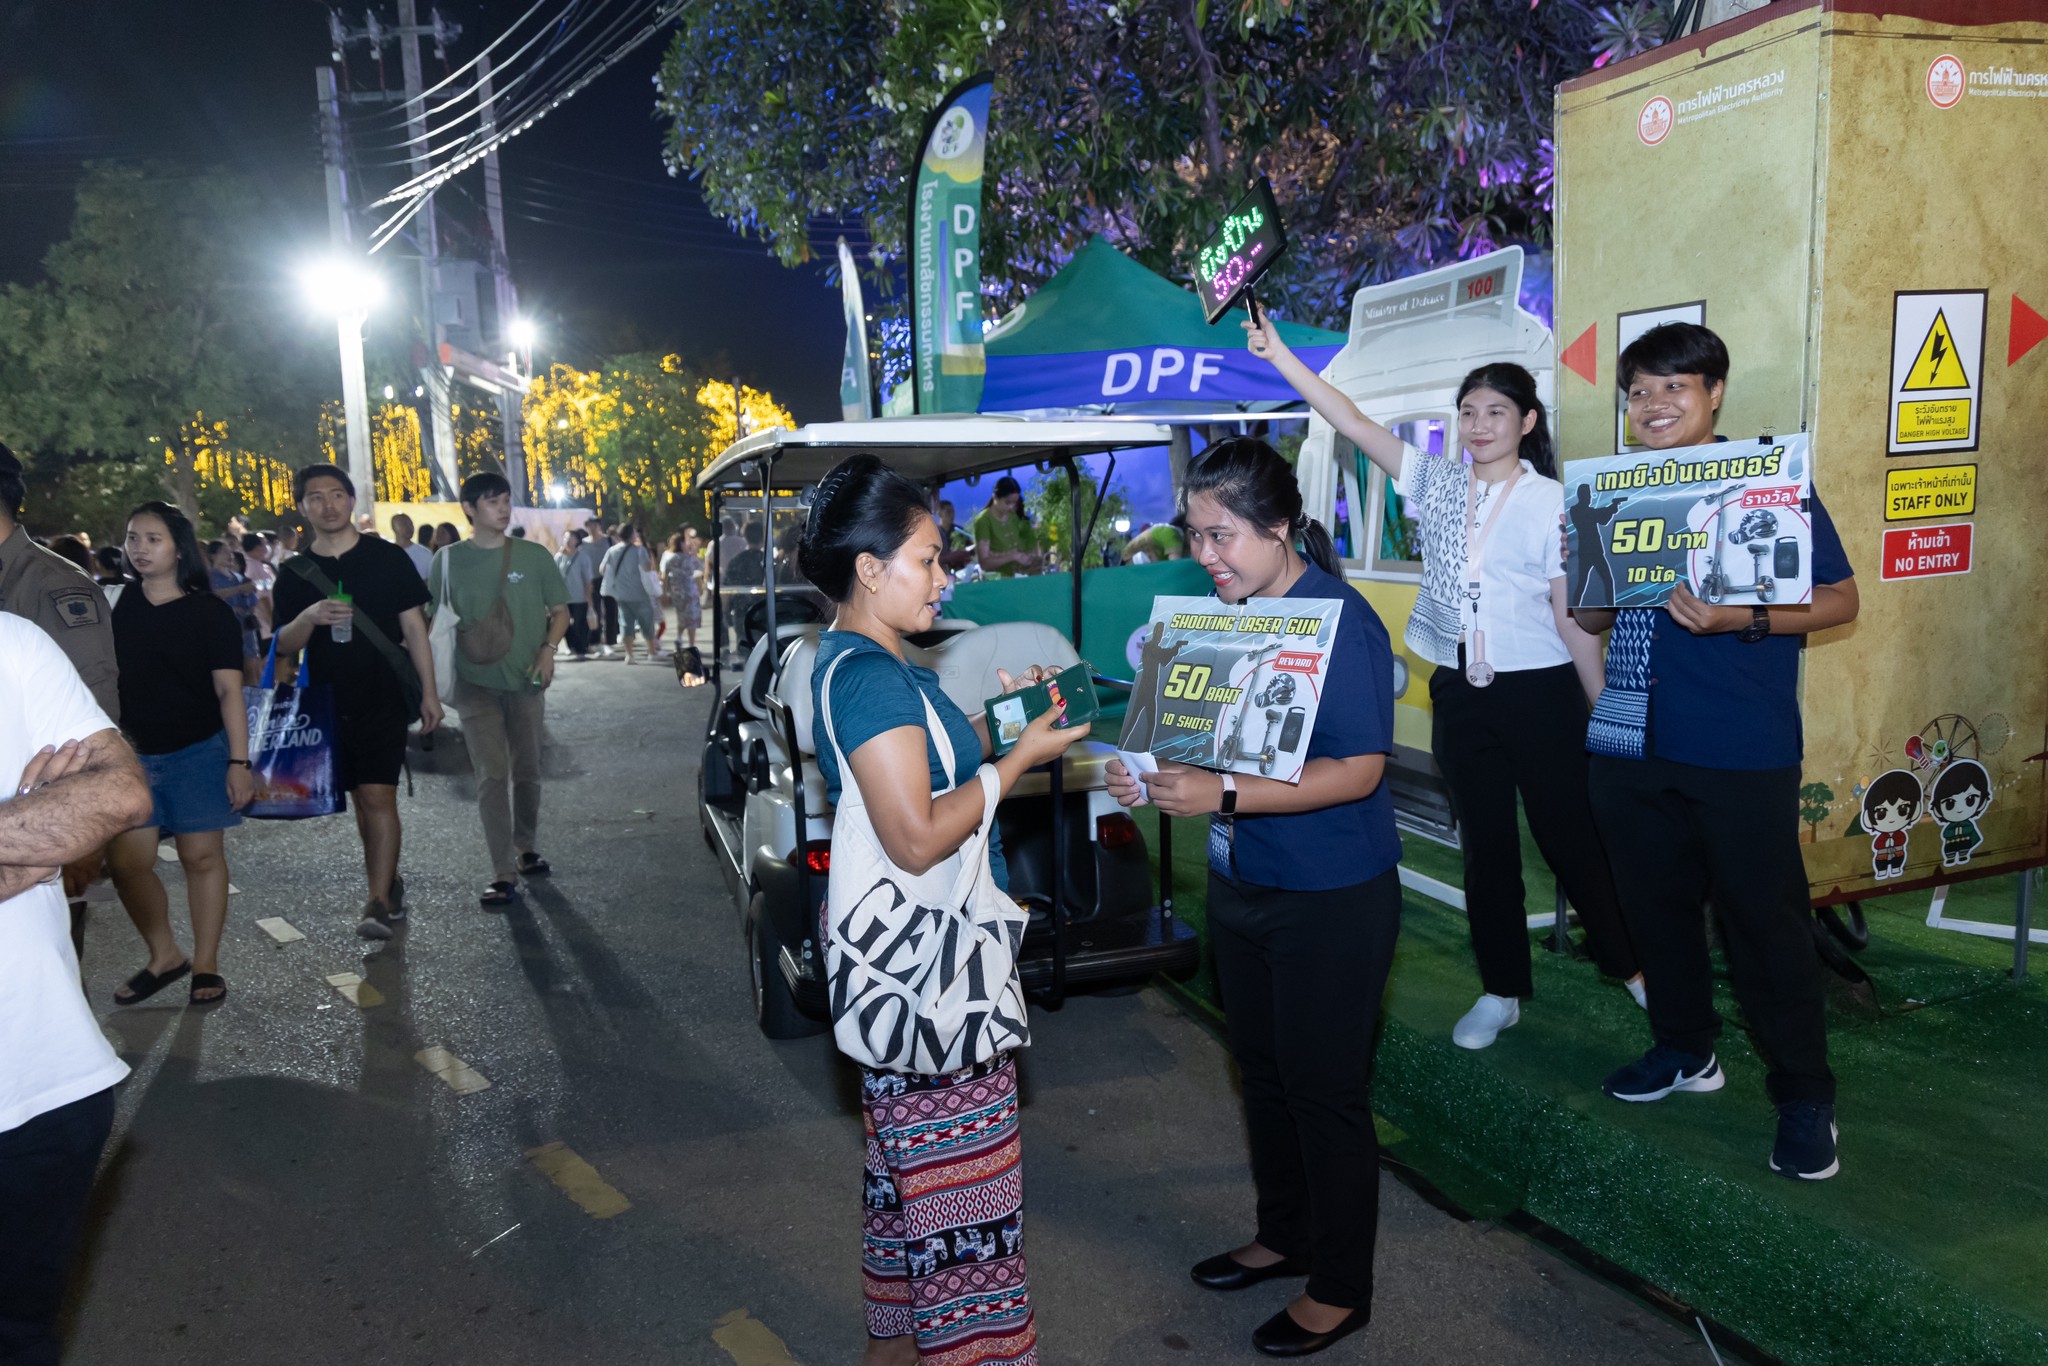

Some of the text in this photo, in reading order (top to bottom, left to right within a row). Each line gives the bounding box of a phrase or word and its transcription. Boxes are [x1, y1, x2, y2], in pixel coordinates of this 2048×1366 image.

[1677, 69, 1785, 115] การไฟฟ้านครหลวง
[1968, 88, 2006, 98] Metropolitan
[2007, 89, 2037, 99] Electricity
[1677, 87, 1784, 125] Metropolitan Electricity Authority
[953, 203, 976, 322] DPF
[1467, 274, 1494, 300] 100
[1364, 304, 1398, 320] Ministry
[1399, 300, 1408, 312] of
[1101, 347, 1225, 397] DPF
[1915, 404, 1957, 415] ระวังอันตราย
[1916, 415, 1956, 427] ไฟฟ้าแรงสูง
[1900, 427, 1967, 439] DANGER HIGH VOLTAGE
[1596, 446, 1785, 491] เกมยิงปืนเลเซอร์
[1890, 472, 1972, 492] เฉพาะเจ้าหน้าที่เท่านั้น
[1745, 490, 1792, 505] รางวัล
[1892, 491, 1968, 512] STAFF ONLY
[1611, 517, 1666, 555] 50
[1666, 530, 1709, 551] บาท
[1907, 529, 1951, 551] ห้ามเข้า
[1895, 552, 1960, 573] NO ENTRY
[1626, 565, 1676, 583] 10 นัด
[1170, 613, 1323, 637] SHOOTING LASER GUN
[1278, 656, 1313, 668] REWARD
[1163, 663, 1243, 705] 50 BAHT
[1161, 712, 1214, 732] 10 SHOTS
